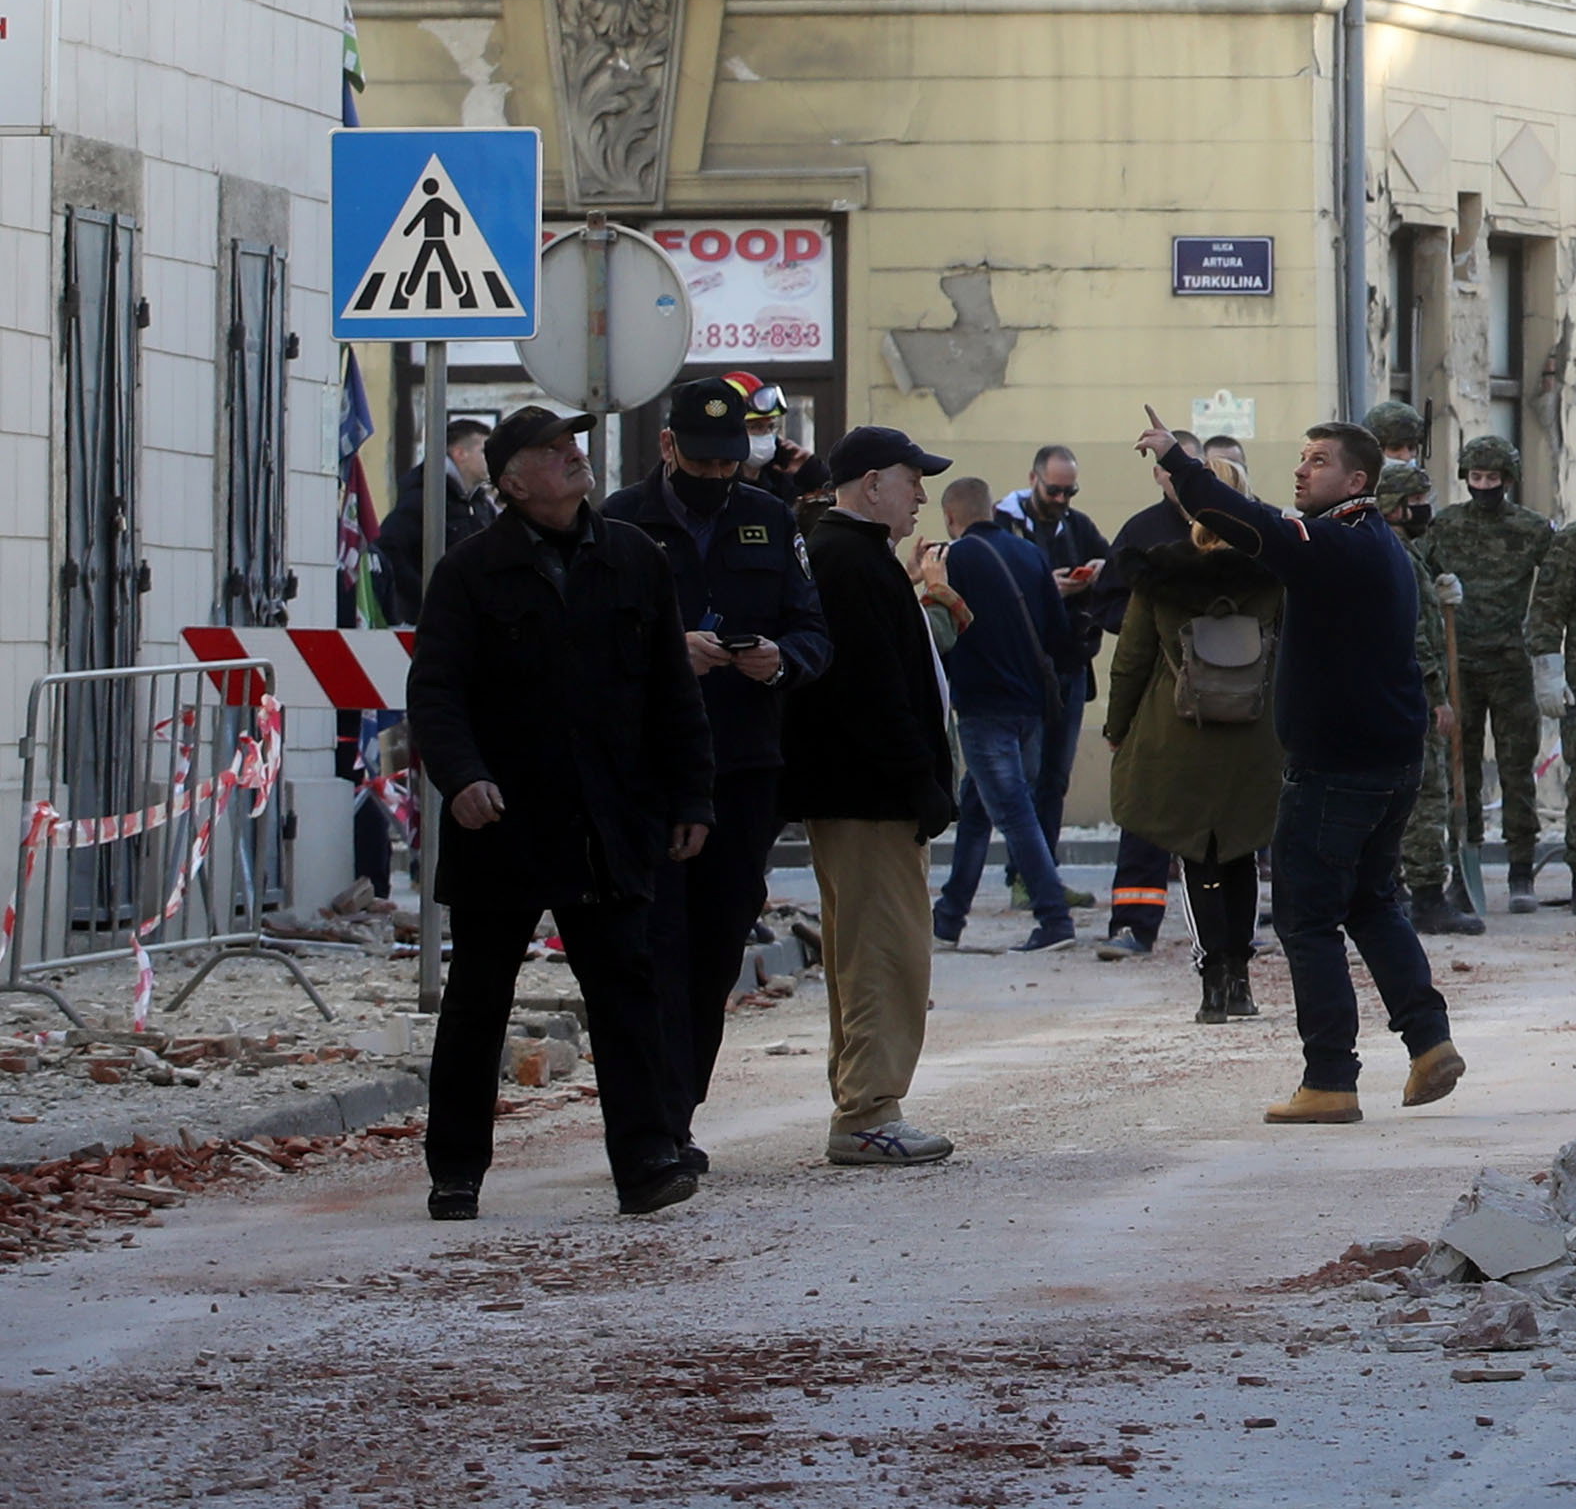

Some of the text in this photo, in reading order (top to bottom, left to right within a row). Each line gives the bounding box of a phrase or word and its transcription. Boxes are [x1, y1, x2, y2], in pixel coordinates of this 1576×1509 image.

[653, 228, 822, 262] FOOD
[1202, 256, 1244, 268] ARTURA
[1182, 275, 1264, 289] TURKULINA
